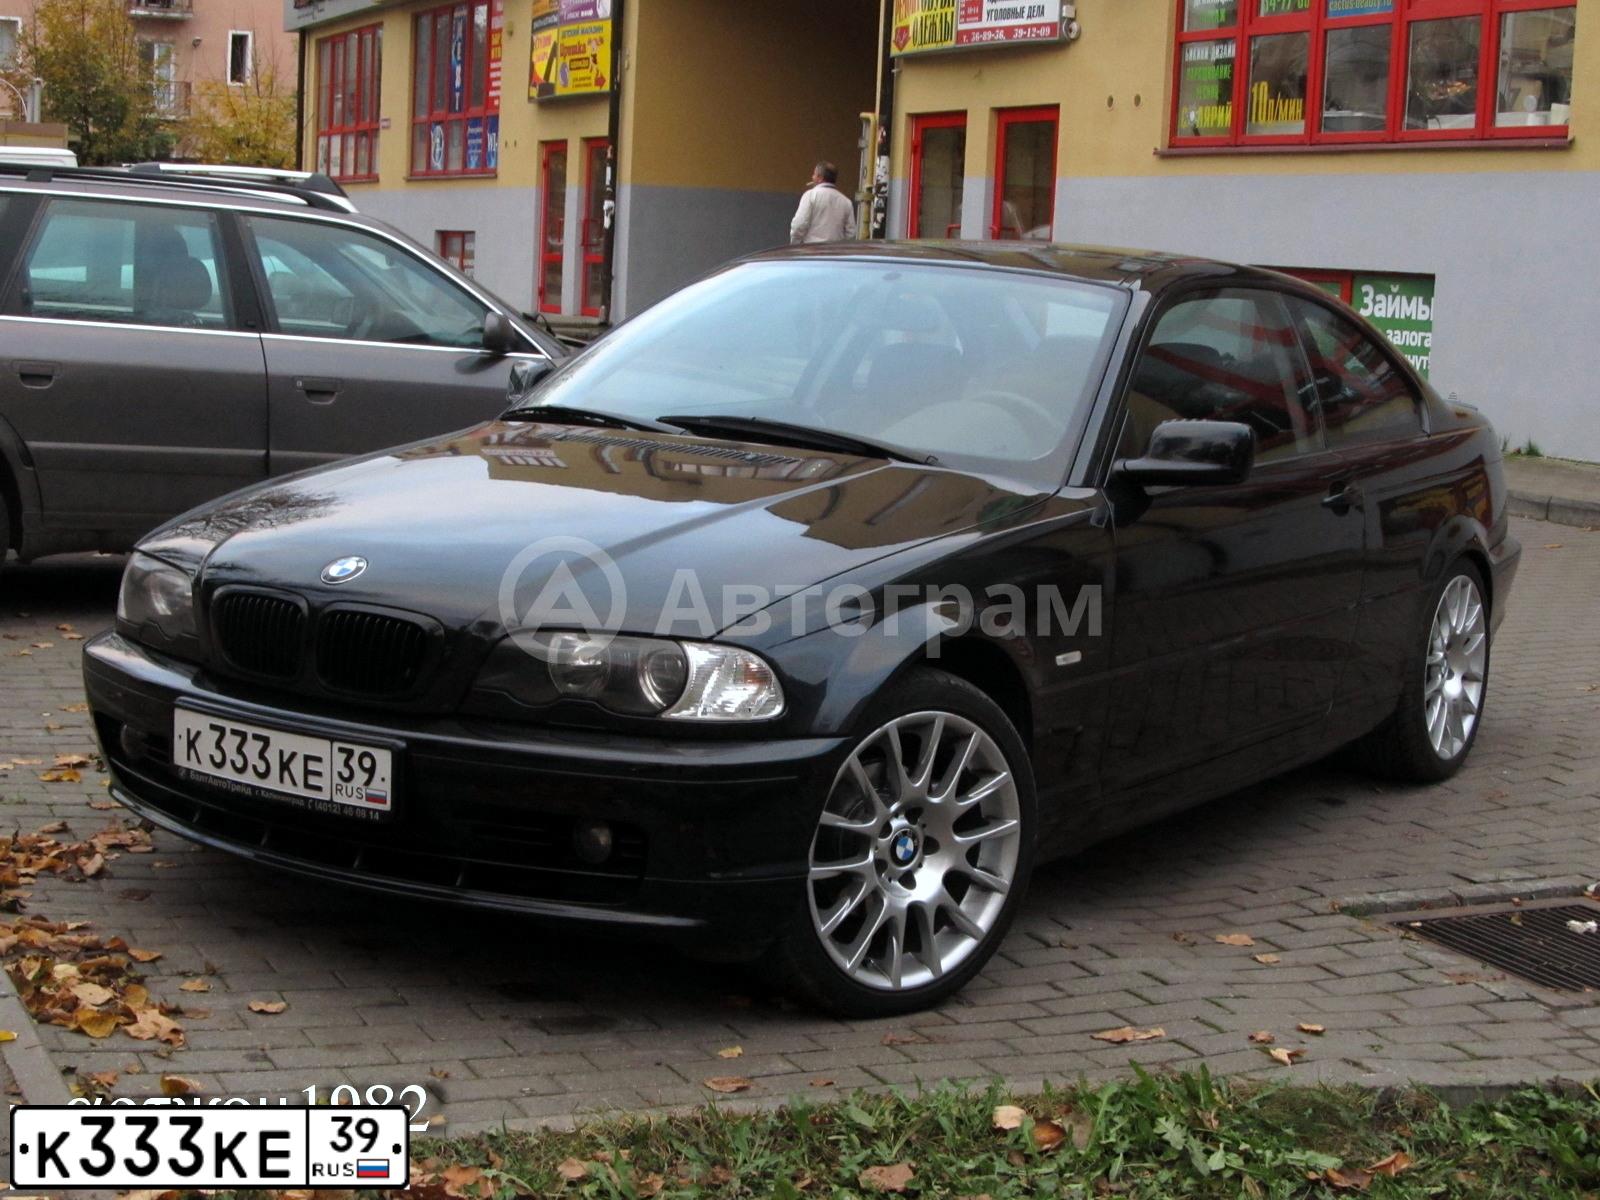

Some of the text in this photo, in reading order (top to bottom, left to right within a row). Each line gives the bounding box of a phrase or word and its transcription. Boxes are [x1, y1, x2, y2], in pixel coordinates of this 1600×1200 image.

[986, 6, 1025, 22] УГОЛОВНЫЕ
[1027, 5, 1045, 19] ДЕЛА
[1181, 101, 1232, 128] СЛЯРИЙ
[1359, 284, 1434, 321] Займы
[186, 723, 377, 792] К333КЕ 39
[335, 783, 364, 800] RUS
